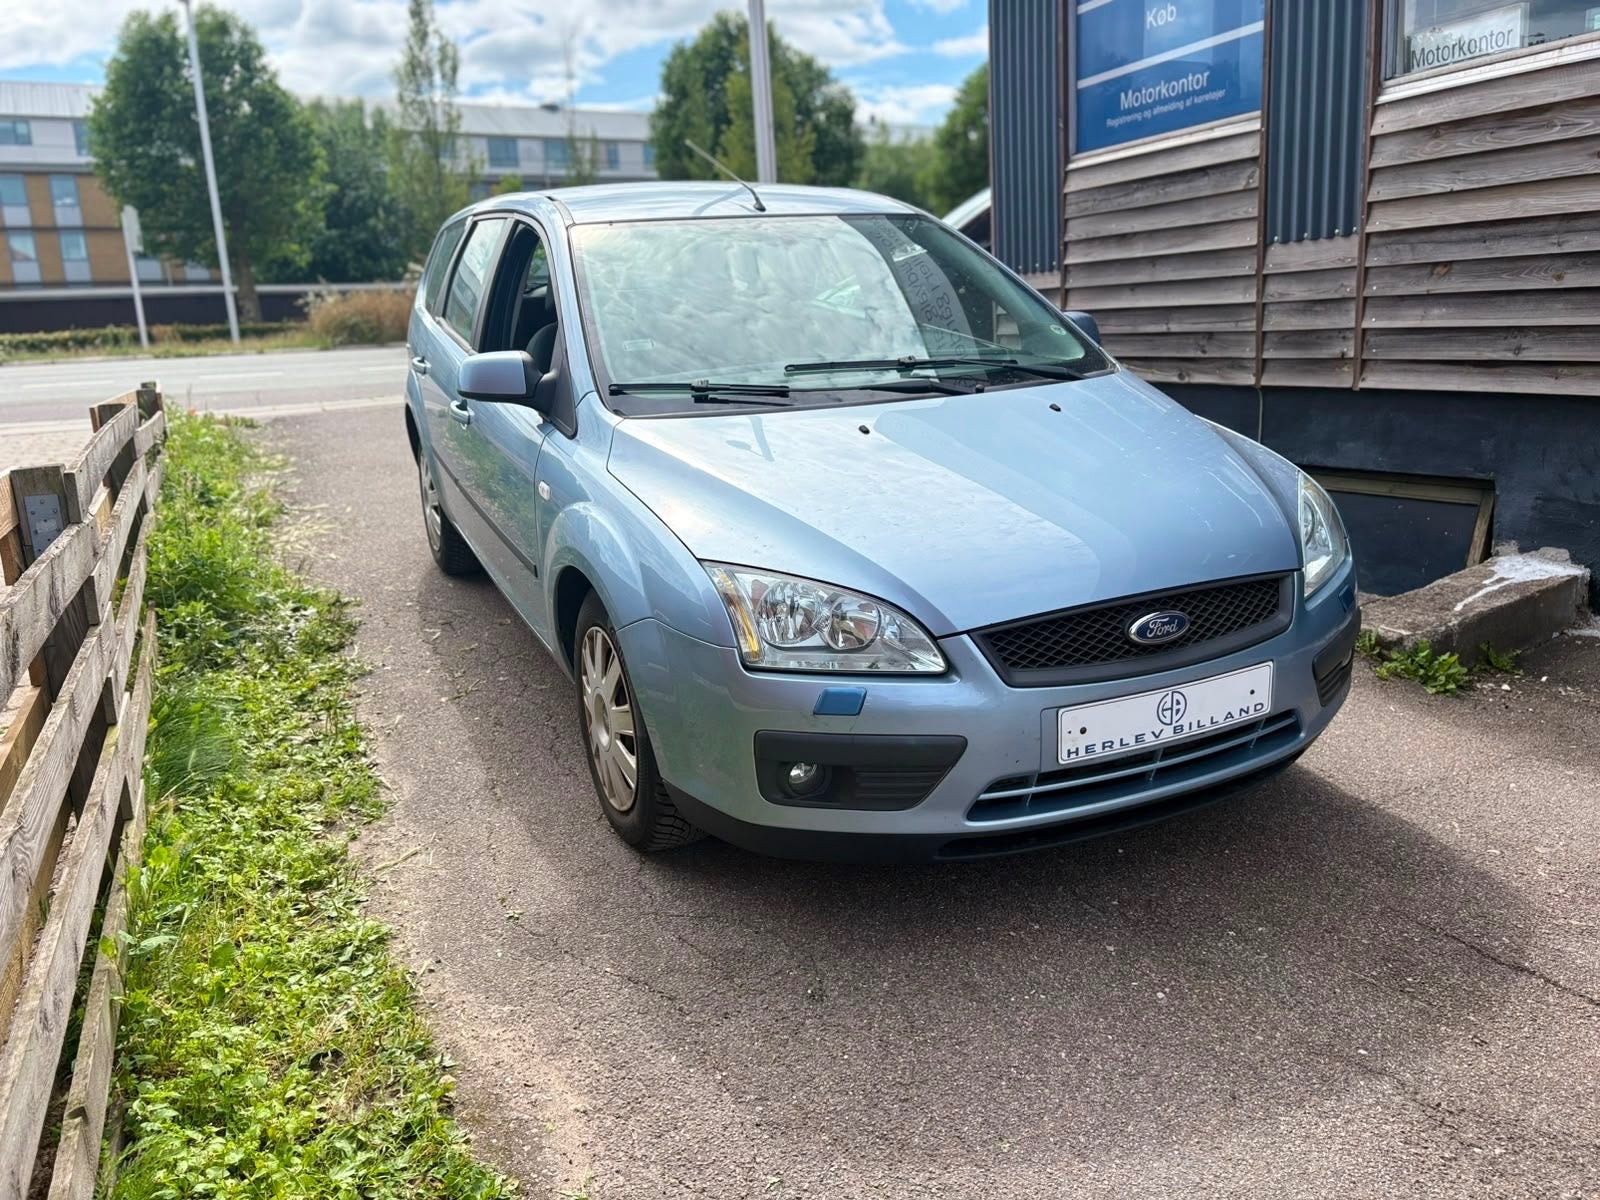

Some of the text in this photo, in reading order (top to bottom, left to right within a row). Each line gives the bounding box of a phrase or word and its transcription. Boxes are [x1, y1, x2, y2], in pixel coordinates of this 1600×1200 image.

[1146, 3, 1176, 29] Køb
[1412, 28, 1514, 69] Motorkontor
[1120, 71, 1210, 111] Motorkontor
[1147, 617, 1178, 638] Ford
[1067, 702, 1264, 759] HERLEV BILLAND
